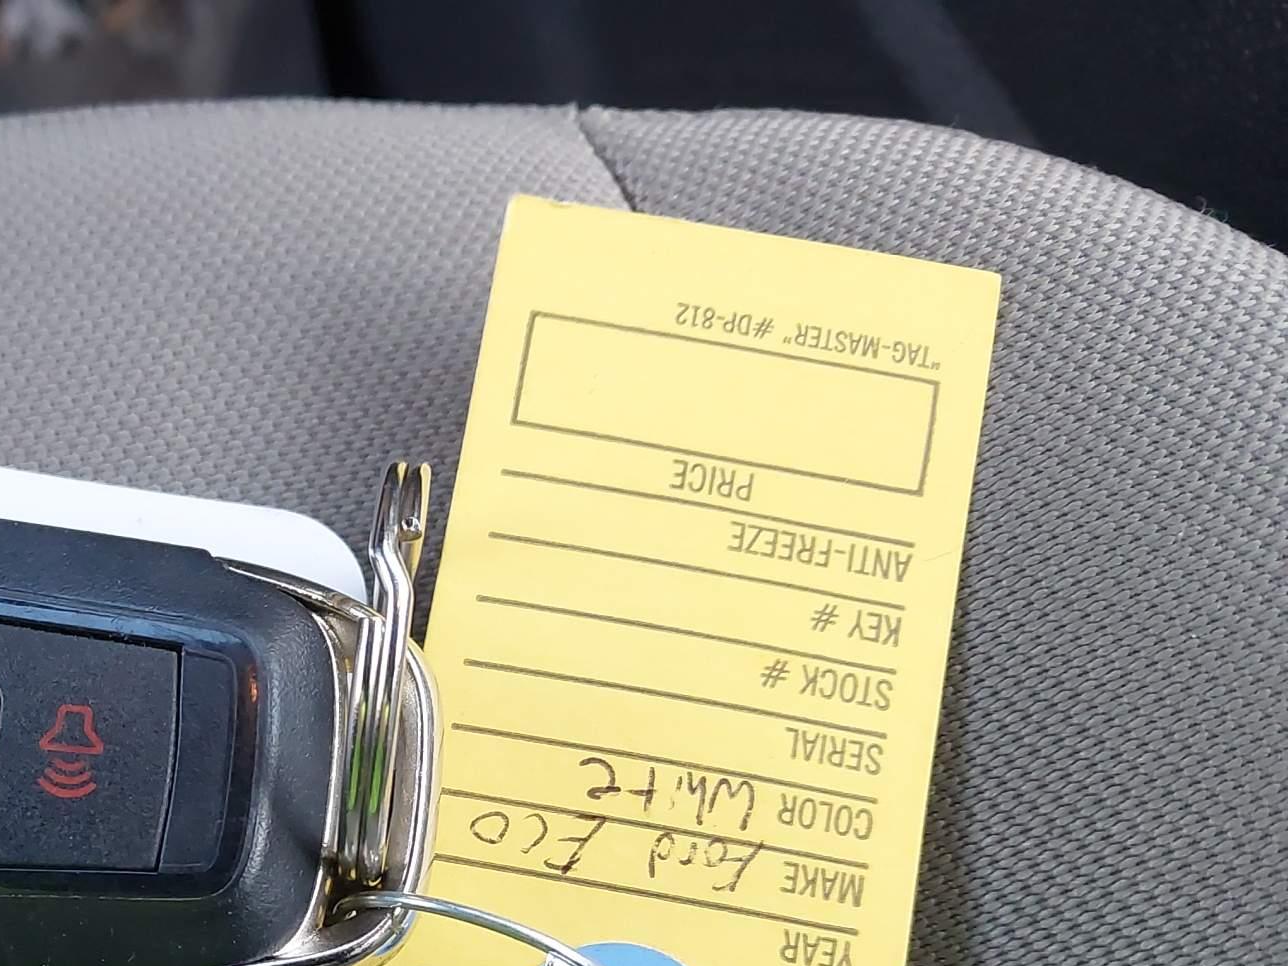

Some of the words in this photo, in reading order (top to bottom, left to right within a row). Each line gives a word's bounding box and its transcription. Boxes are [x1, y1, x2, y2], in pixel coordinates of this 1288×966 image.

[675, 302, 775, 339] #DP-812
[670, 459, 754, 501] PRICE
[728, 521, 913, 583] ANTI-FREEZE
[810, 603, 839, 632] #
[848, 608, 901, 647] KEY
[761, 658, 790, 688] #
[800, 663, 893, 711] STOCK
[785, 727, 884, 775] SERIAL
[579, 757, 756, 830] White
[777, 793, 873, 840] COLOR
[647, 832, 766, 892] Ford
[780, 862, 864, 907] MAKE
